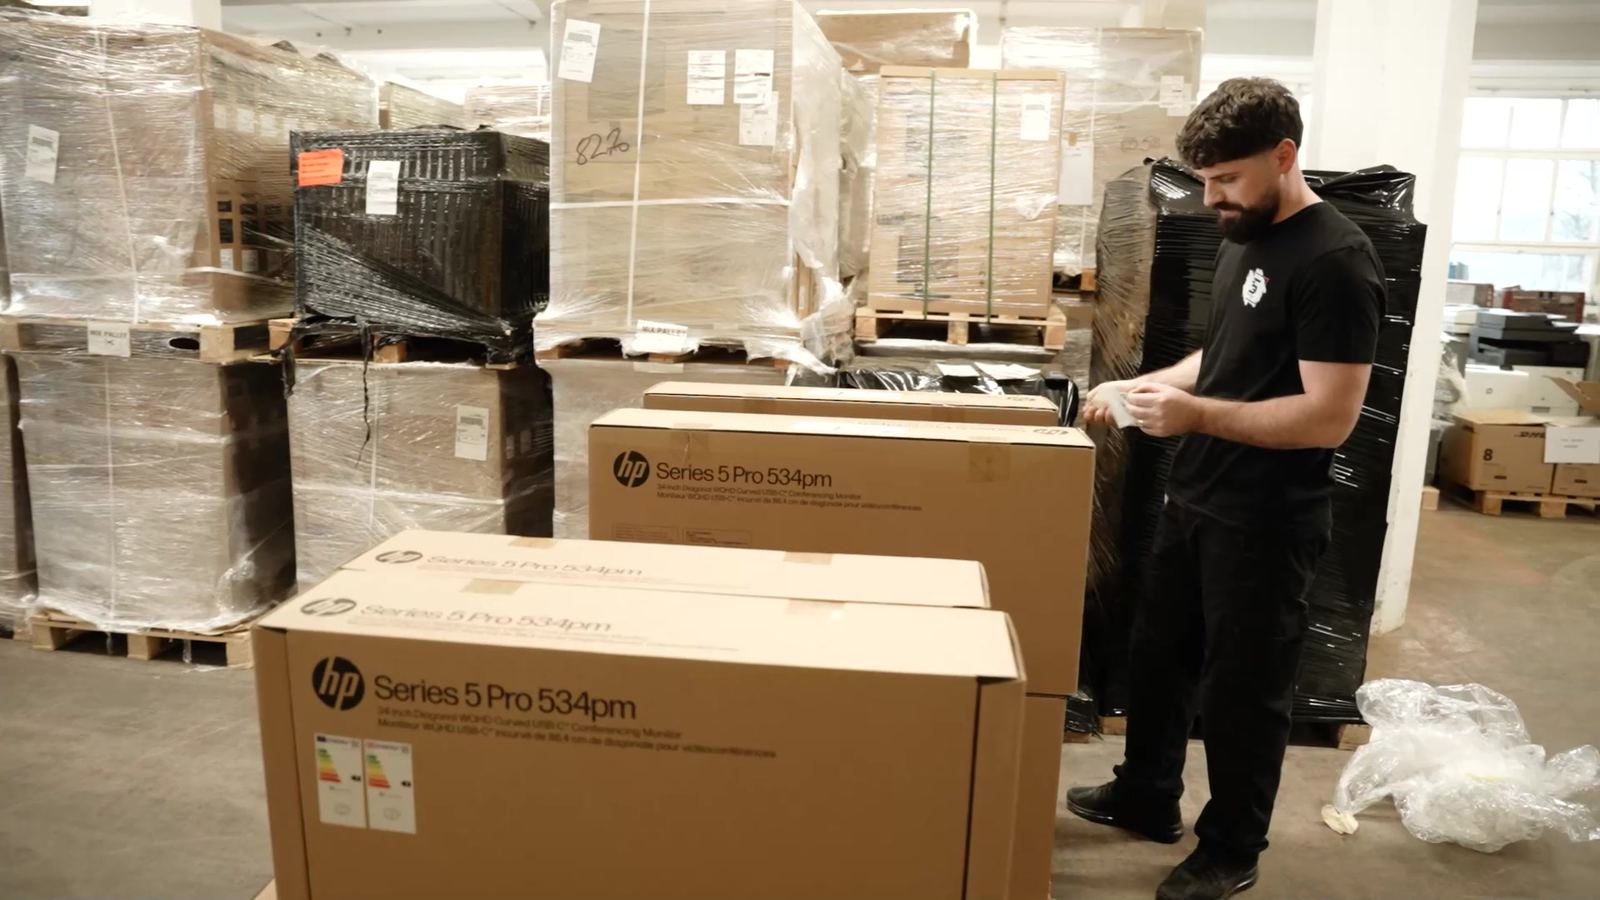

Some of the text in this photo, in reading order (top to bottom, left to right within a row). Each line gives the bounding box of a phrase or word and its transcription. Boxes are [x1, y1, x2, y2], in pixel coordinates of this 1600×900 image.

[613, 450, 832, 490] hp Series 5 Pro 534pm
[1482, 448, 1494, 462] 8
[360, 604, 444, 620] Series
[467, 611, 513, 625] Pro
[516, 614, 612, 633] 534pm
[312, 656, 636, 722] hp Series 5 Pro 534pm
